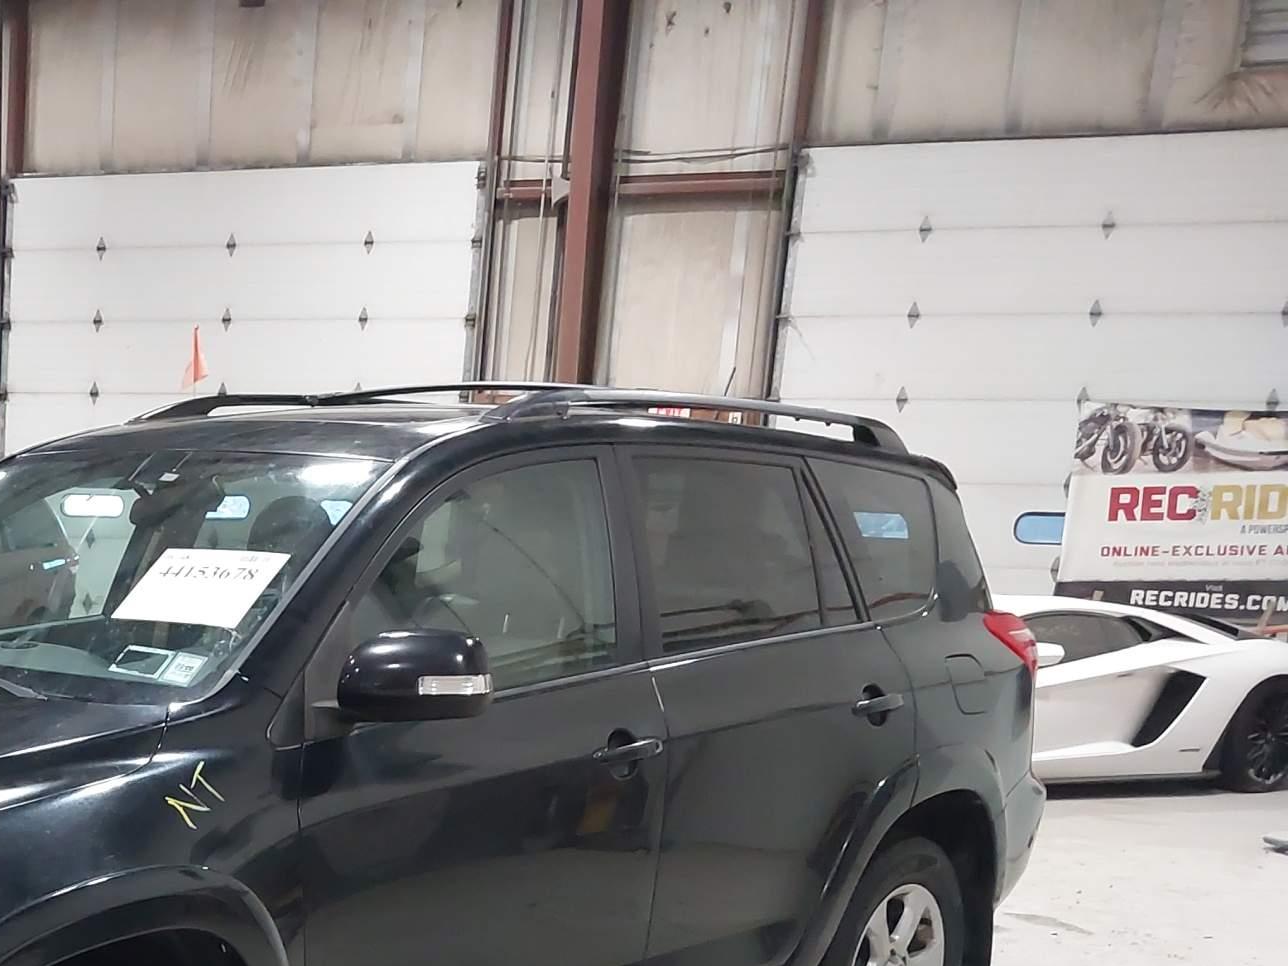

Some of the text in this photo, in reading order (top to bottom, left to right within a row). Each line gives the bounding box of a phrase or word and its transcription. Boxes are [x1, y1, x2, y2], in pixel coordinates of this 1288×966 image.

[1108, 486, 1200, 521] REC
[1100, 544, 1288, 557] ONLINE-EXCLUSIVE A
[159, 565, 260, 581] 44153678
[1130, 589, 1288, 611] RECRIDES.COM
